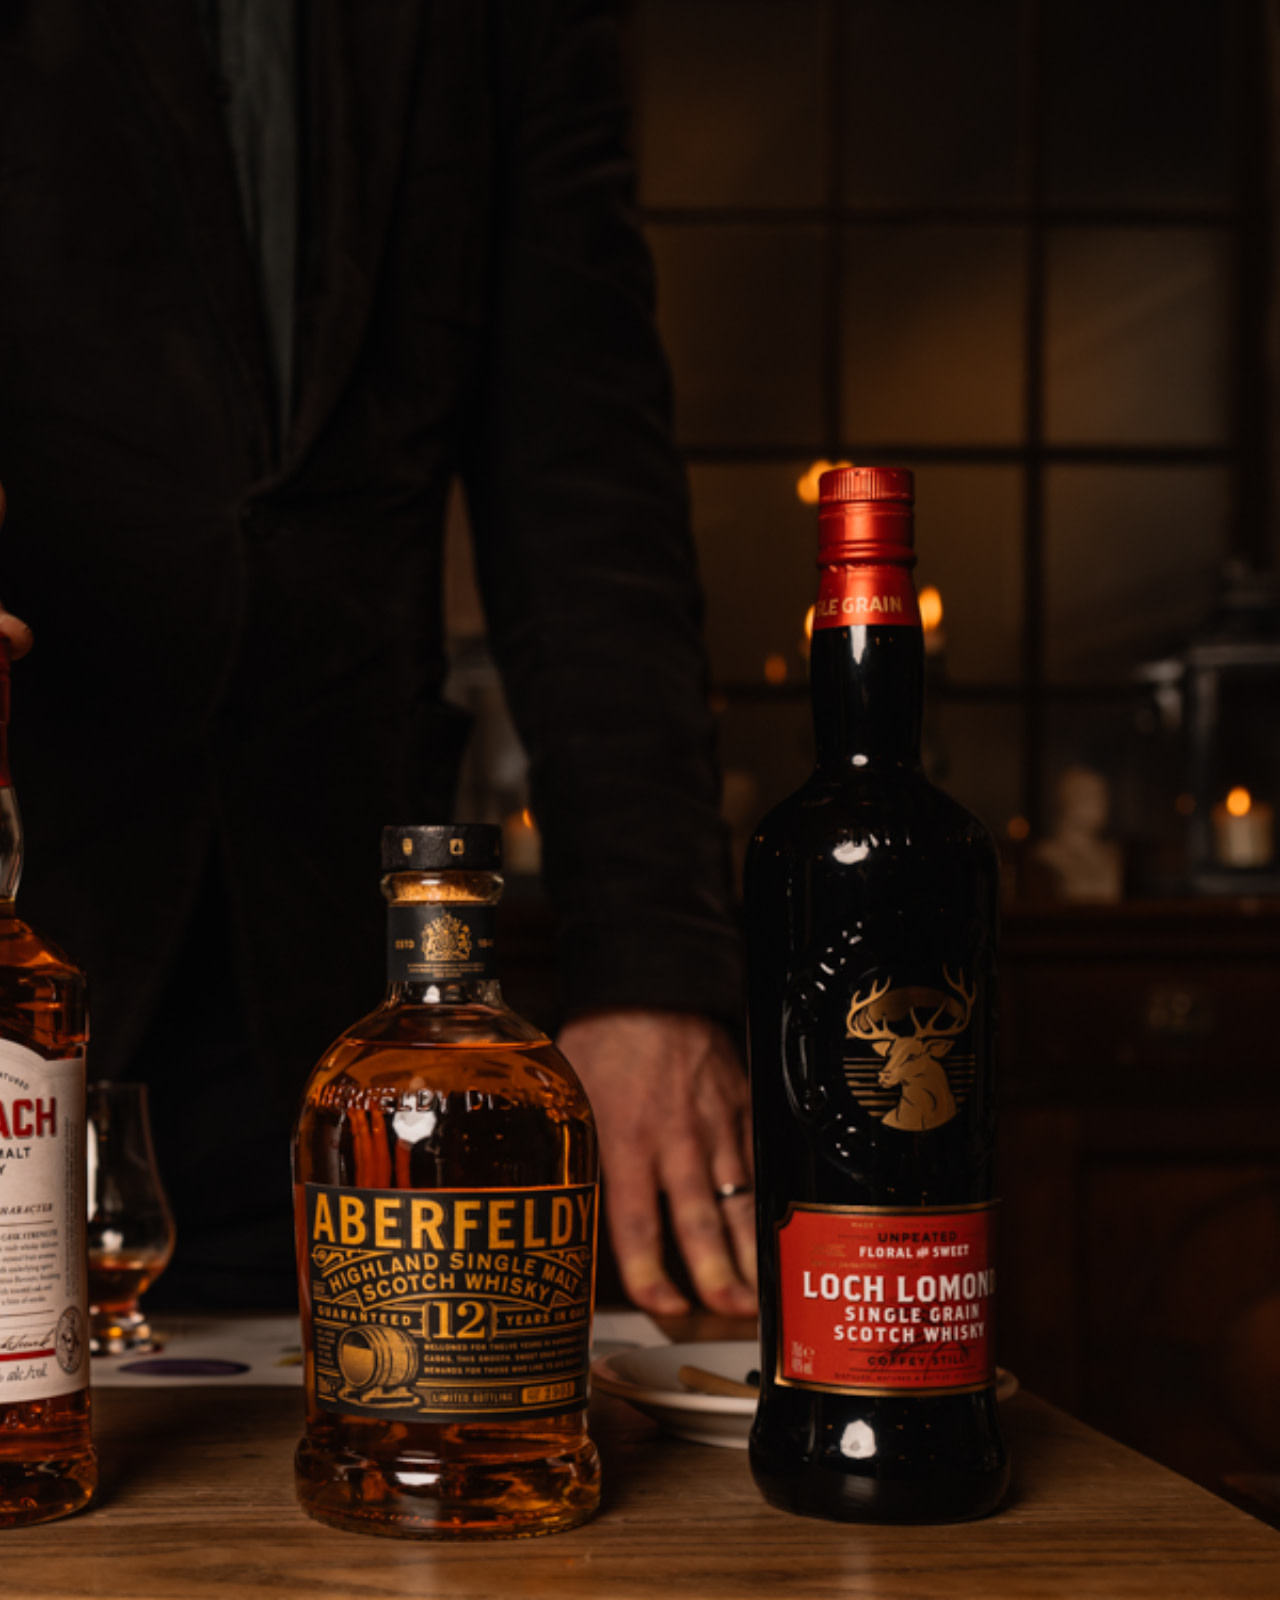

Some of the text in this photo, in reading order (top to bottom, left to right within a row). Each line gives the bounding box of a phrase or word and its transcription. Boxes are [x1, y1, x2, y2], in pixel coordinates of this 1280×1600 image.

[842, 596, 902, 613] GRAIN
[313, 1192, 593, 1250] ABERFELDY
[878, 1231, 958, 1243] UNPEATED
[859, 1246, 913, 1258] FLORAL
[932, 1244, 969, 1258] SWEET
[329, 1252, 439, 1294] HIGHLAND
[450, 1252, 536, 1276] SINGLE
[542, 1262, 580, 1293] MALT
[362, 1273, 552, 1302] SCOTCH WHISKY
[803, 1271, 884, 1303] LOCH
[317, 1305, 412, 1326] GUARANTEED
[431, 1301, 486, 1338] 12
[505, 1312, 550, 1327] YEARS
[845, 1303, 980, 1323] SINGLE GRAIN
[834, 1322, 985, 1343] SCOTCH WHISKY
[471, 1343, 487, 1351] FOR
[489, 1342, 517, 1351] TWELVE
[867, 1355, 965, 1367] COFFEY STILL
[424, 1366, 463, 1375] REWARDS
[465, 1366, 481, 1374] FOR
[484, 1366, 509, 1374] THOSE
[432, 1392, 469, 1403] LIMITED
[473, 1391, 513, 1403] BOTTLING
